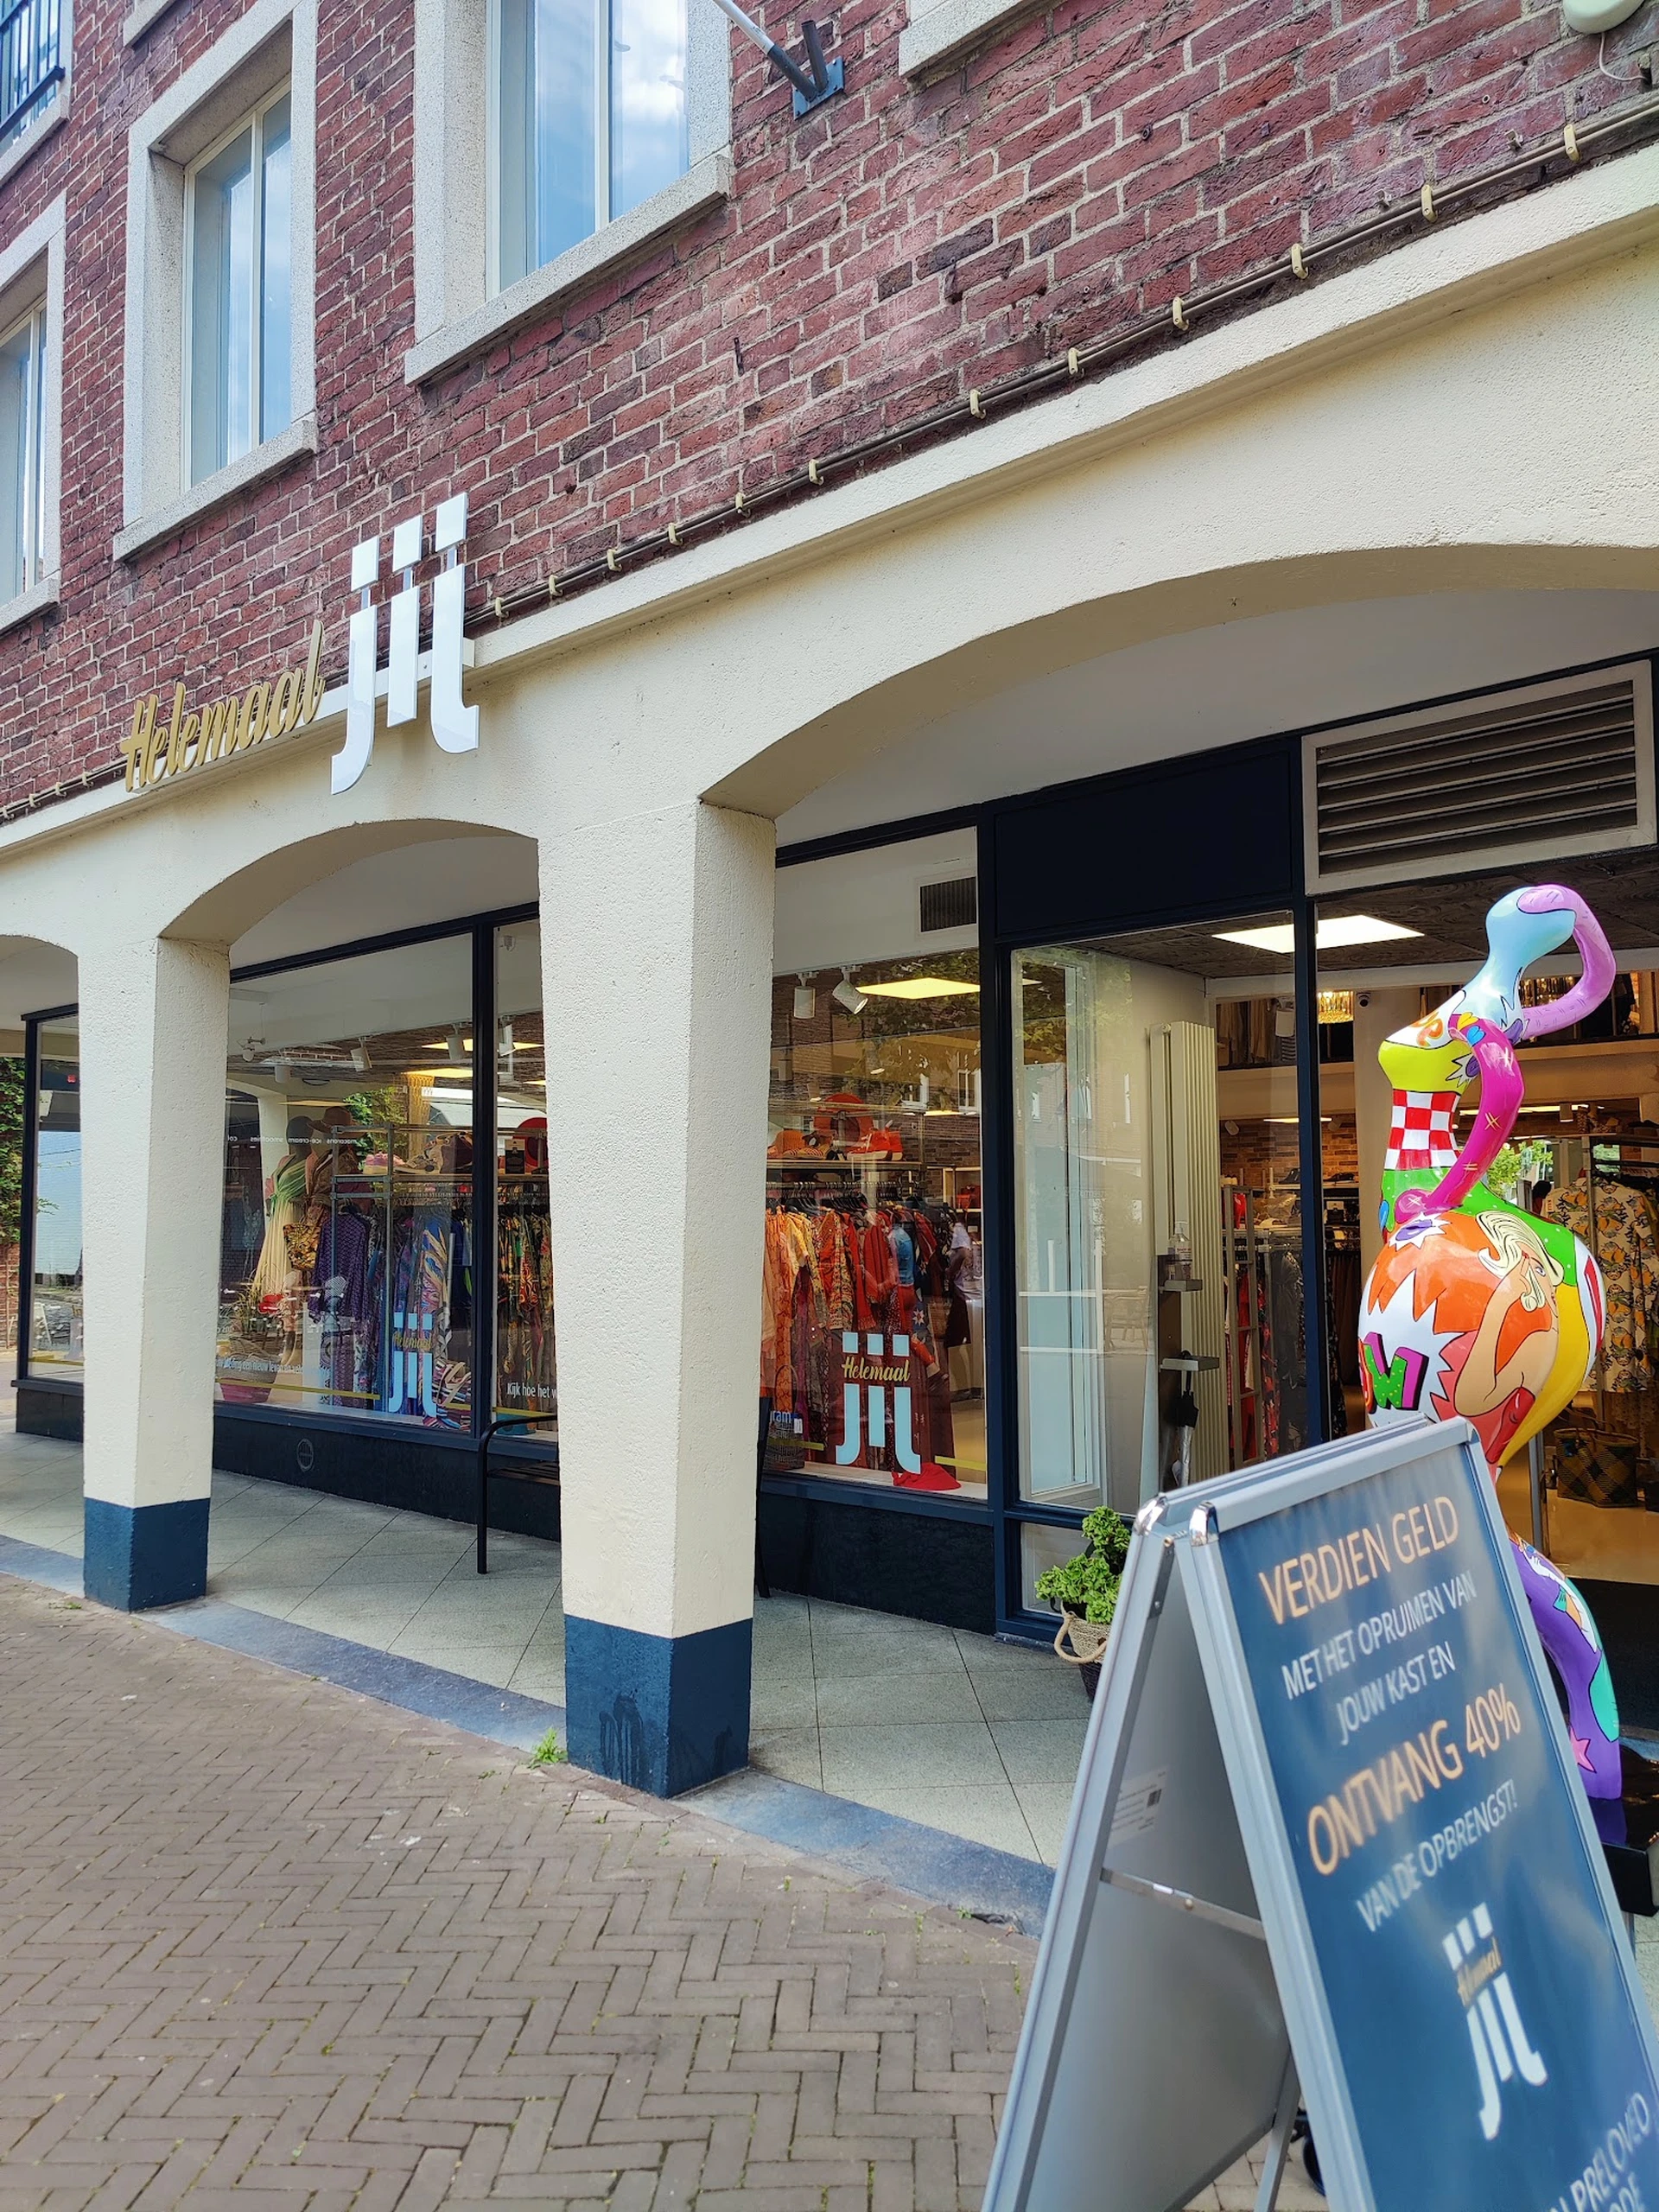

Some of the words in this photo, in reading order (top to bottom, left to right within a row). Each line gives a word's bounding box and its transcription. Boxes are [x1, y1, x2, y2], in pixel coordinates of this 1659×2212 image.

[120, 620, 325, 792] Helemaal
[507, 1382, 521, 1398] Kijk
[522, 1382, 536, 1396] hoe
[537, 1383, 550, 1398] het
[842, 1355, 910, 1382] Helemaal
[1258, 1523, 1390, 1625] VERDIEN
[1392, 1496, 1460, 1565] GELD
[1281, 1651, 1322, 1701] MET
[1321, 1629, 1356, 1676] HET
[1357, 1594, 1445, 1656] OPRUIMEN
[1444, 1570, 1478, 1611] VAN
[1336, 1688, 1386, 1745] JOUW
[1386, 1655, 1428, 1700] KAST
[1430, 1641, 1456, 1677] EN
[1307, 1719, 1464, 1876] ONTVANG
[1465, 1682, 1522, 1759] 40%
[1356, 1878, 1400, 1933] VAN
[1395, 1853, 1421, 1897] DE
[1418, 1779, 1519, 1878] OPBRENGST!
